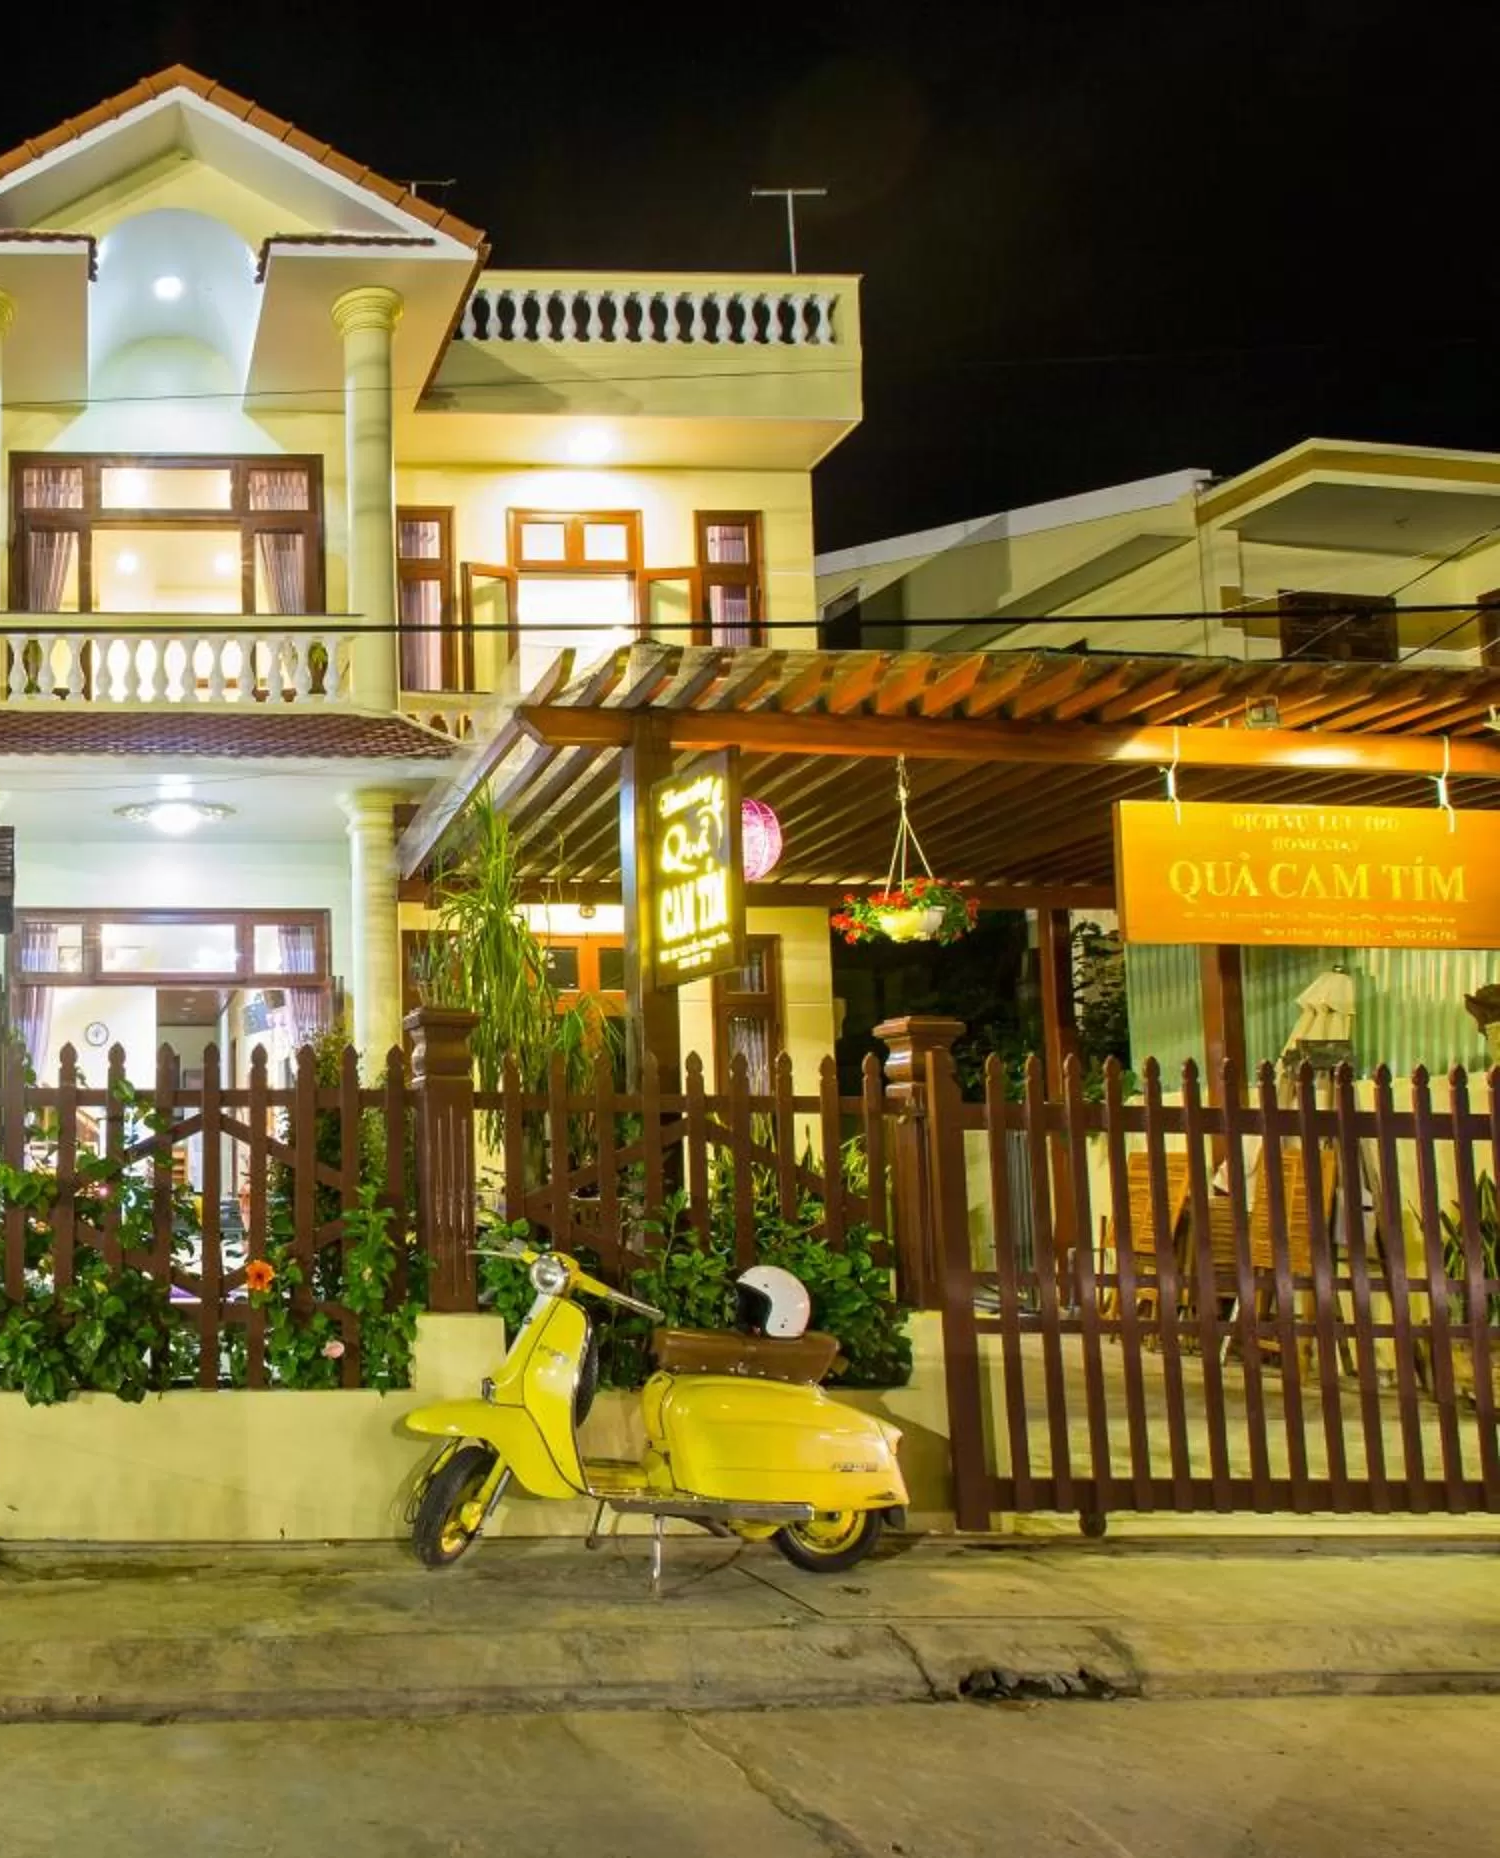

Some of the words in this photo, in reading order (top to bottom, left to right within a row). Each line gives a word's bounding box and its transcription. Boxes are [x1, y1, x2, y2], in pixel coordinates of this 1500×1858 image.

[1168, 851, 1261, 904] QUẢ
[1268, 862, 1370, 901] CAM
[1380, 855, 1469, 903] TÍM
